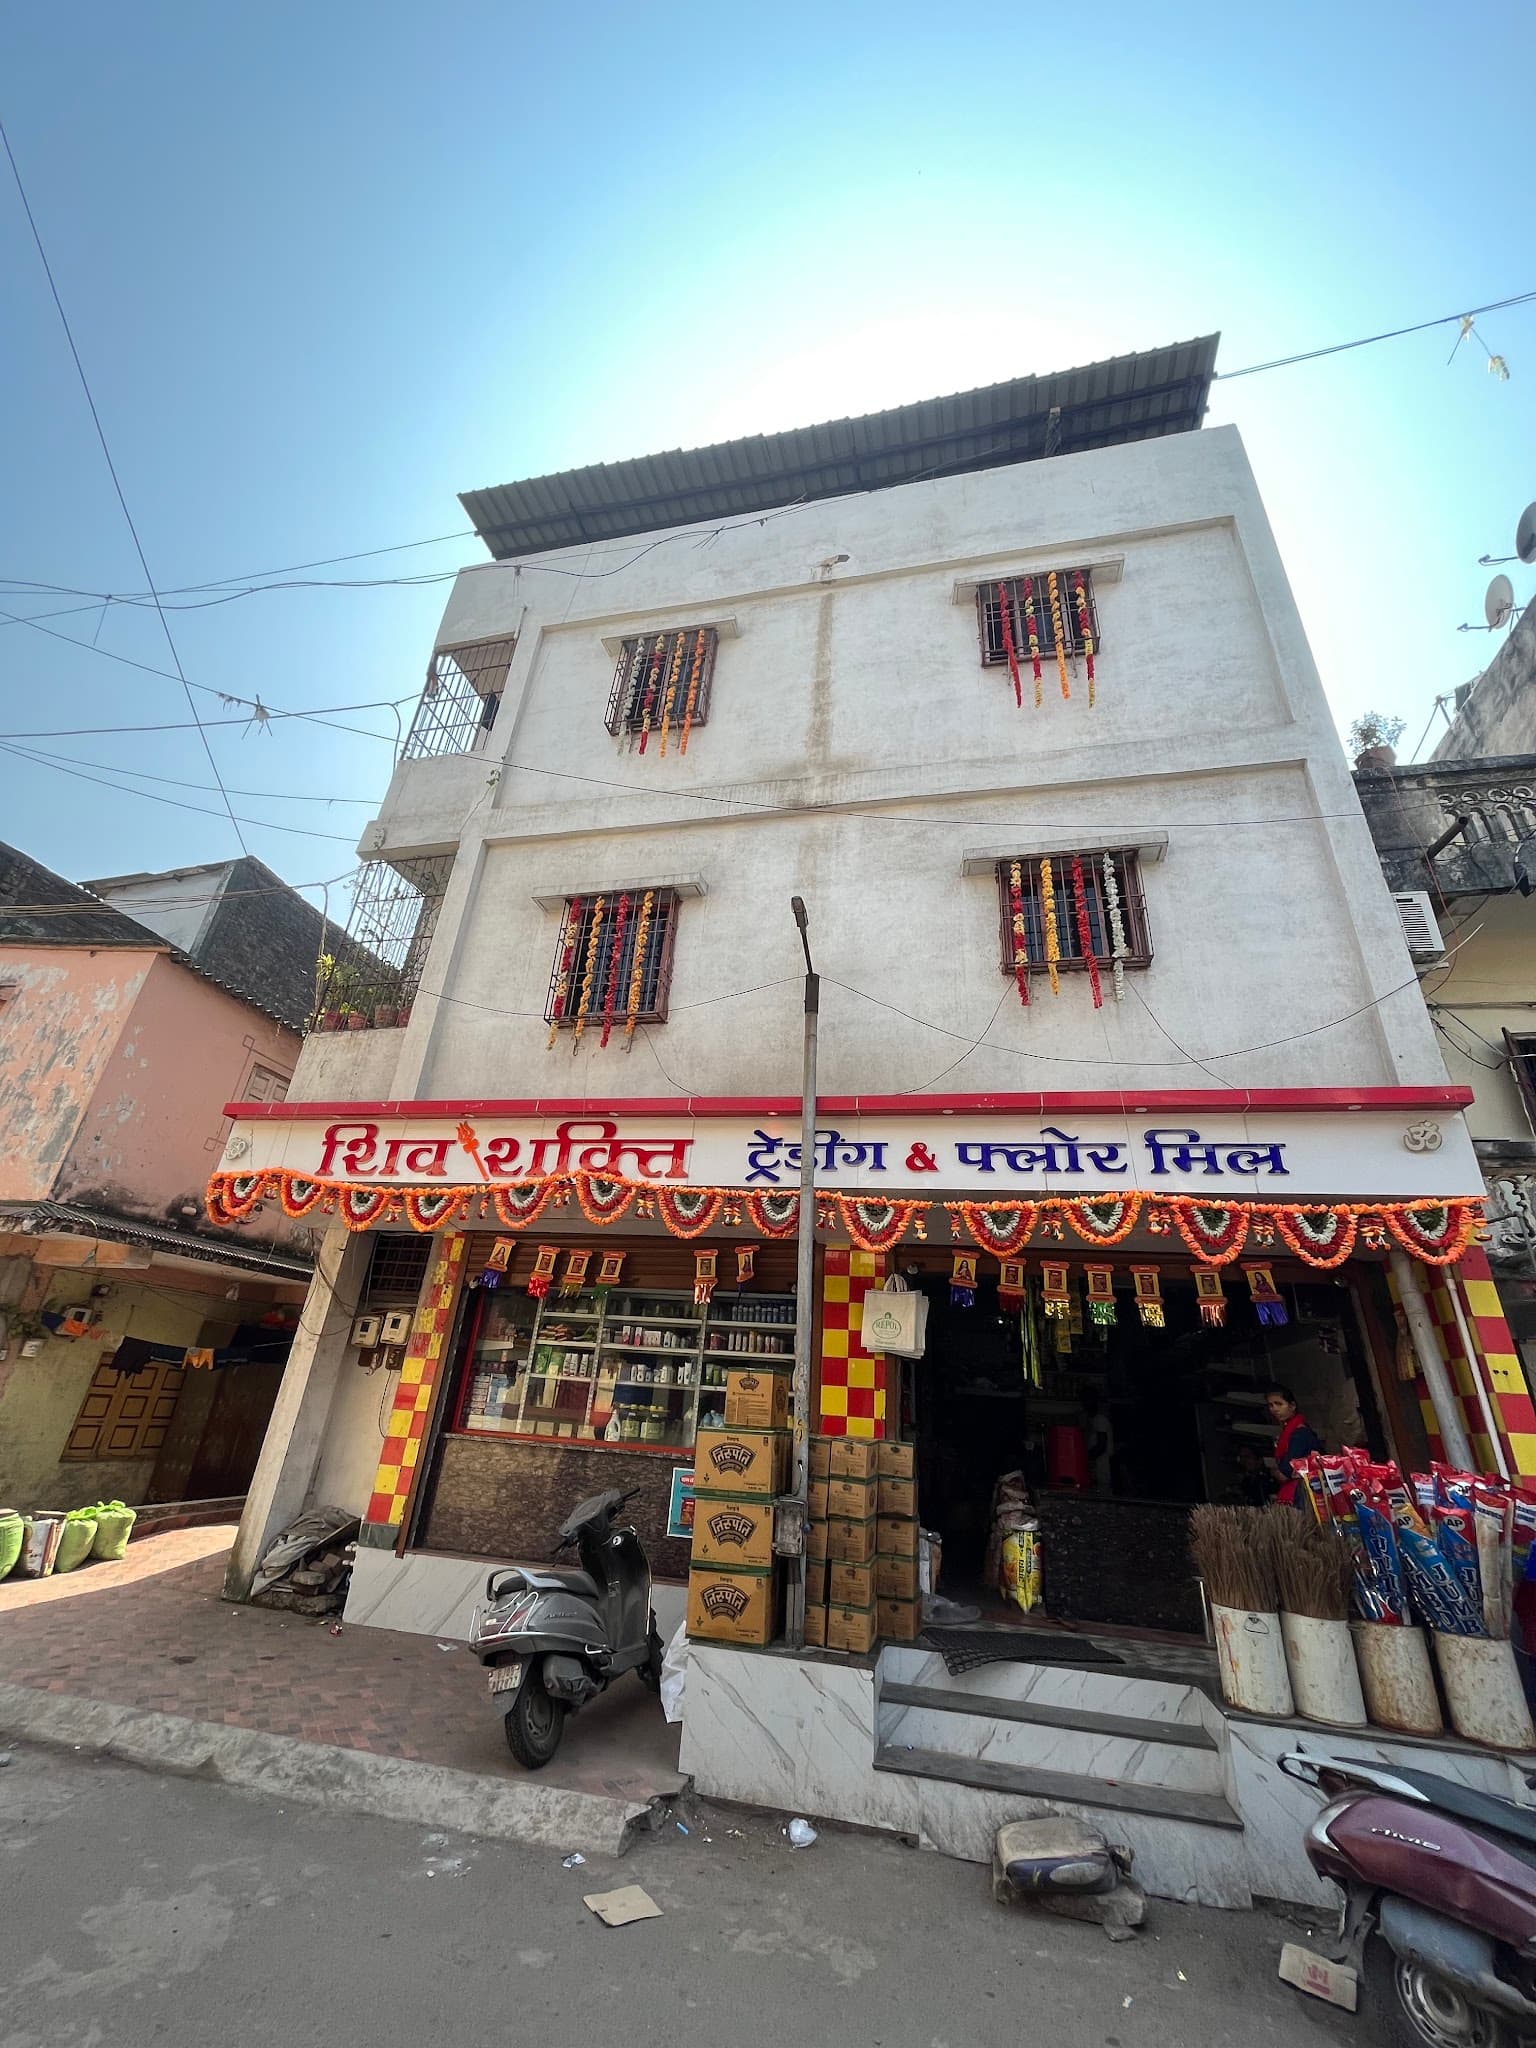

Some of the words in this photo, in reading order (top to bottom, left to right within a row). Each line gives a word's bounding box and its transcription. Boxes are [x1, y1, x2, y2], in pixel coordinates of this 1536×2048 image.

[316, 1122, 456, 1178] शिव
[482, 1120, 694, 1179] शक्ति
[905, 1141, 940, 1172] &
[955, 1126, 1128, 1175] फ्लोर
[1143, 1129, 1290, 1176] मिल
[1398, 1516, 1412, 1528] AP
[1446, 1518, 1463, 1529] AP
[1431, 1562, 1482, 1633] JUMB
